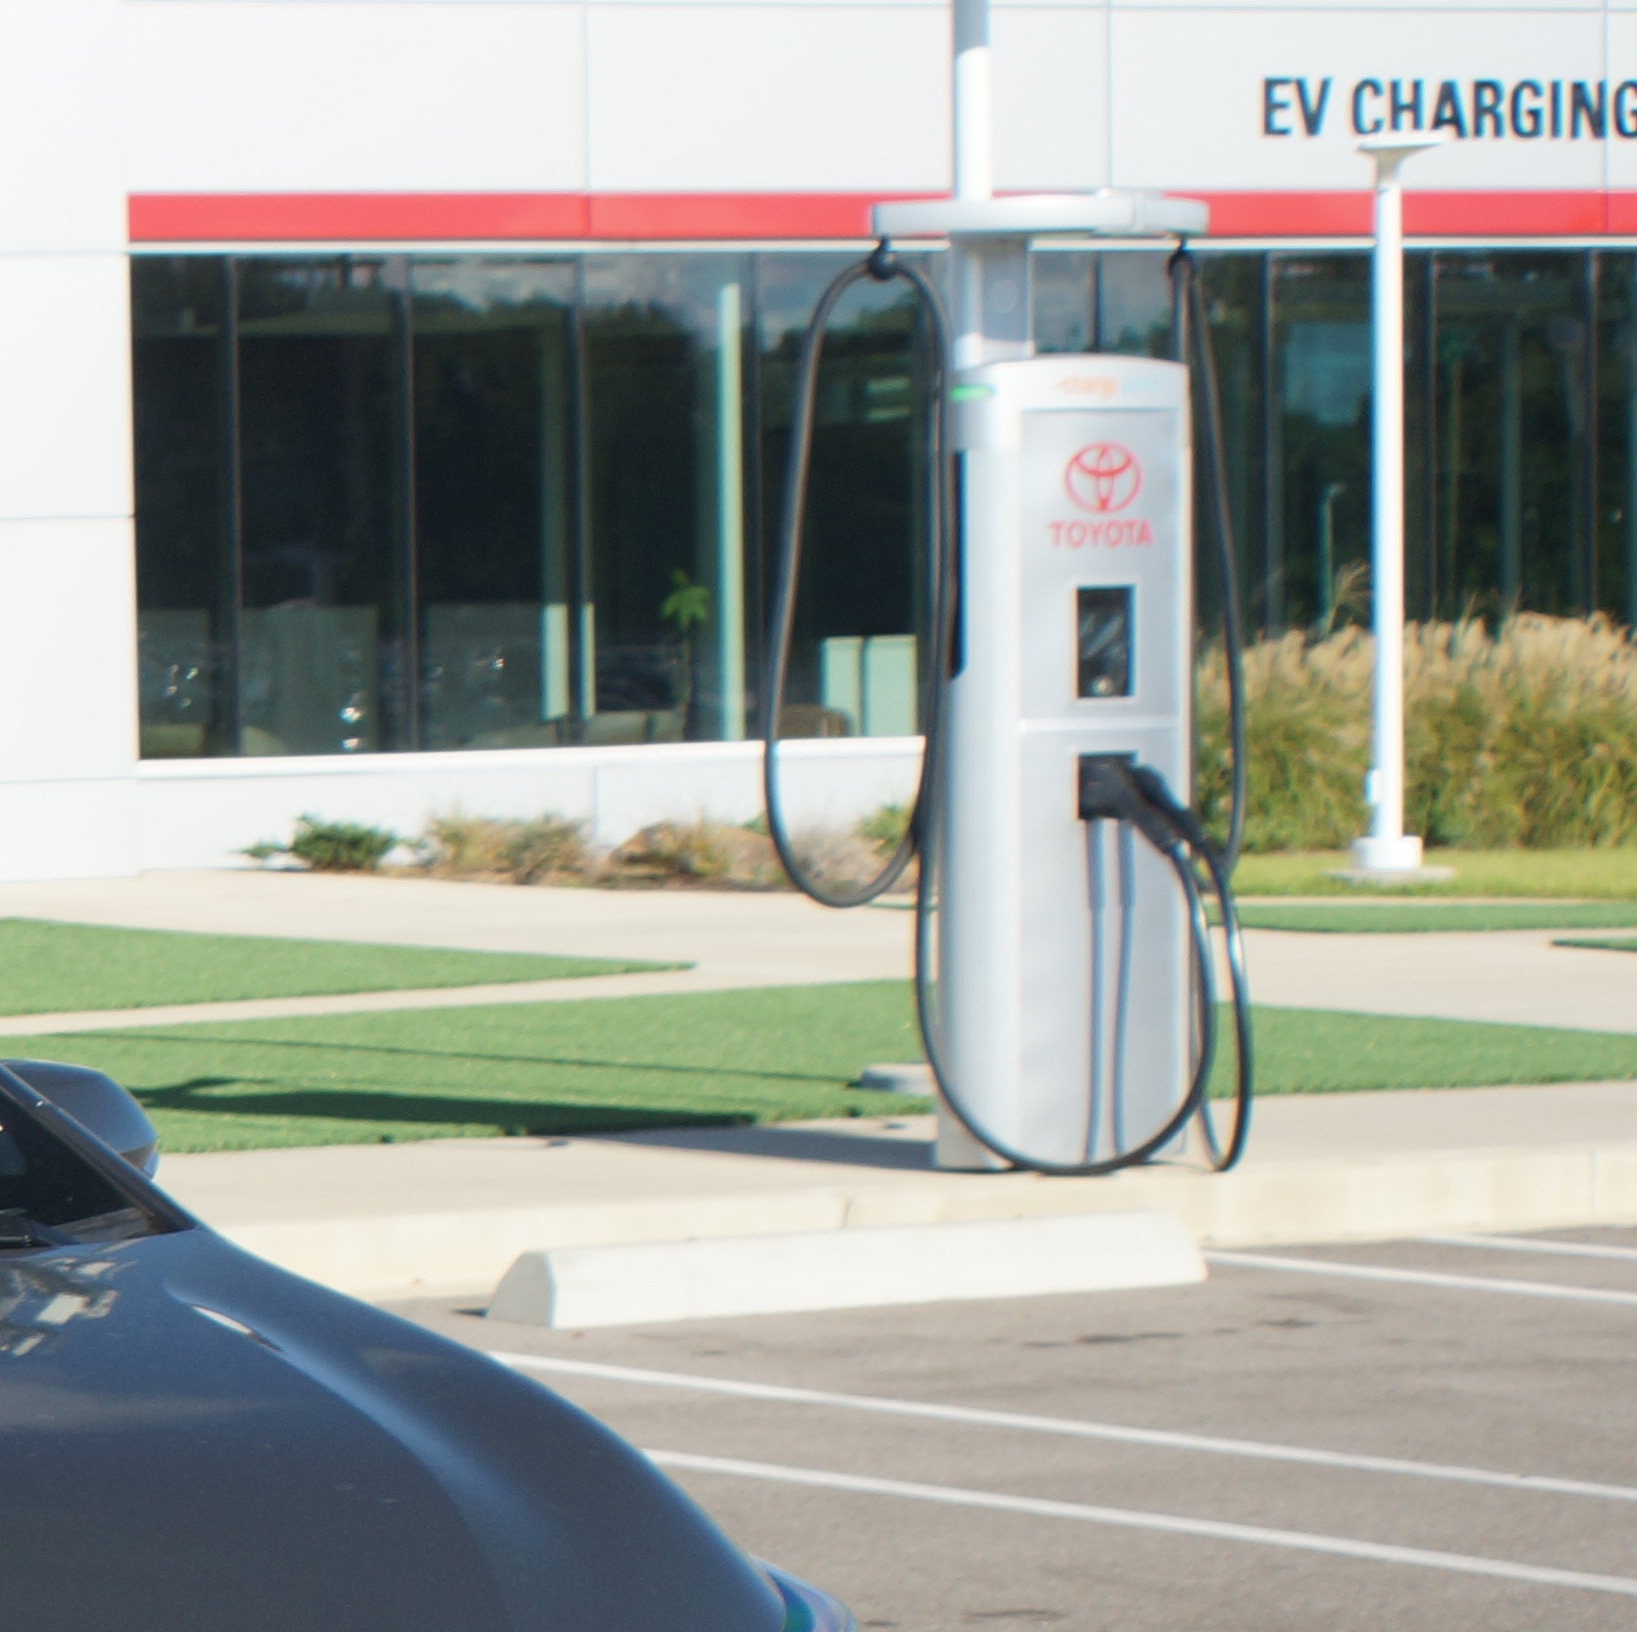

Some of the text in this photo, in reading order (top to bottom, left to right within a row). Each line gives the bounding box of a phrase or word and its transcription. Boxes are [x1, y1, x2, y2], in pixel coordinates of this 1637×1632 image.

[1263, 78, 1637, 139] EV CHARGING
[1048, 519, 1156, 548] TOYOTA
